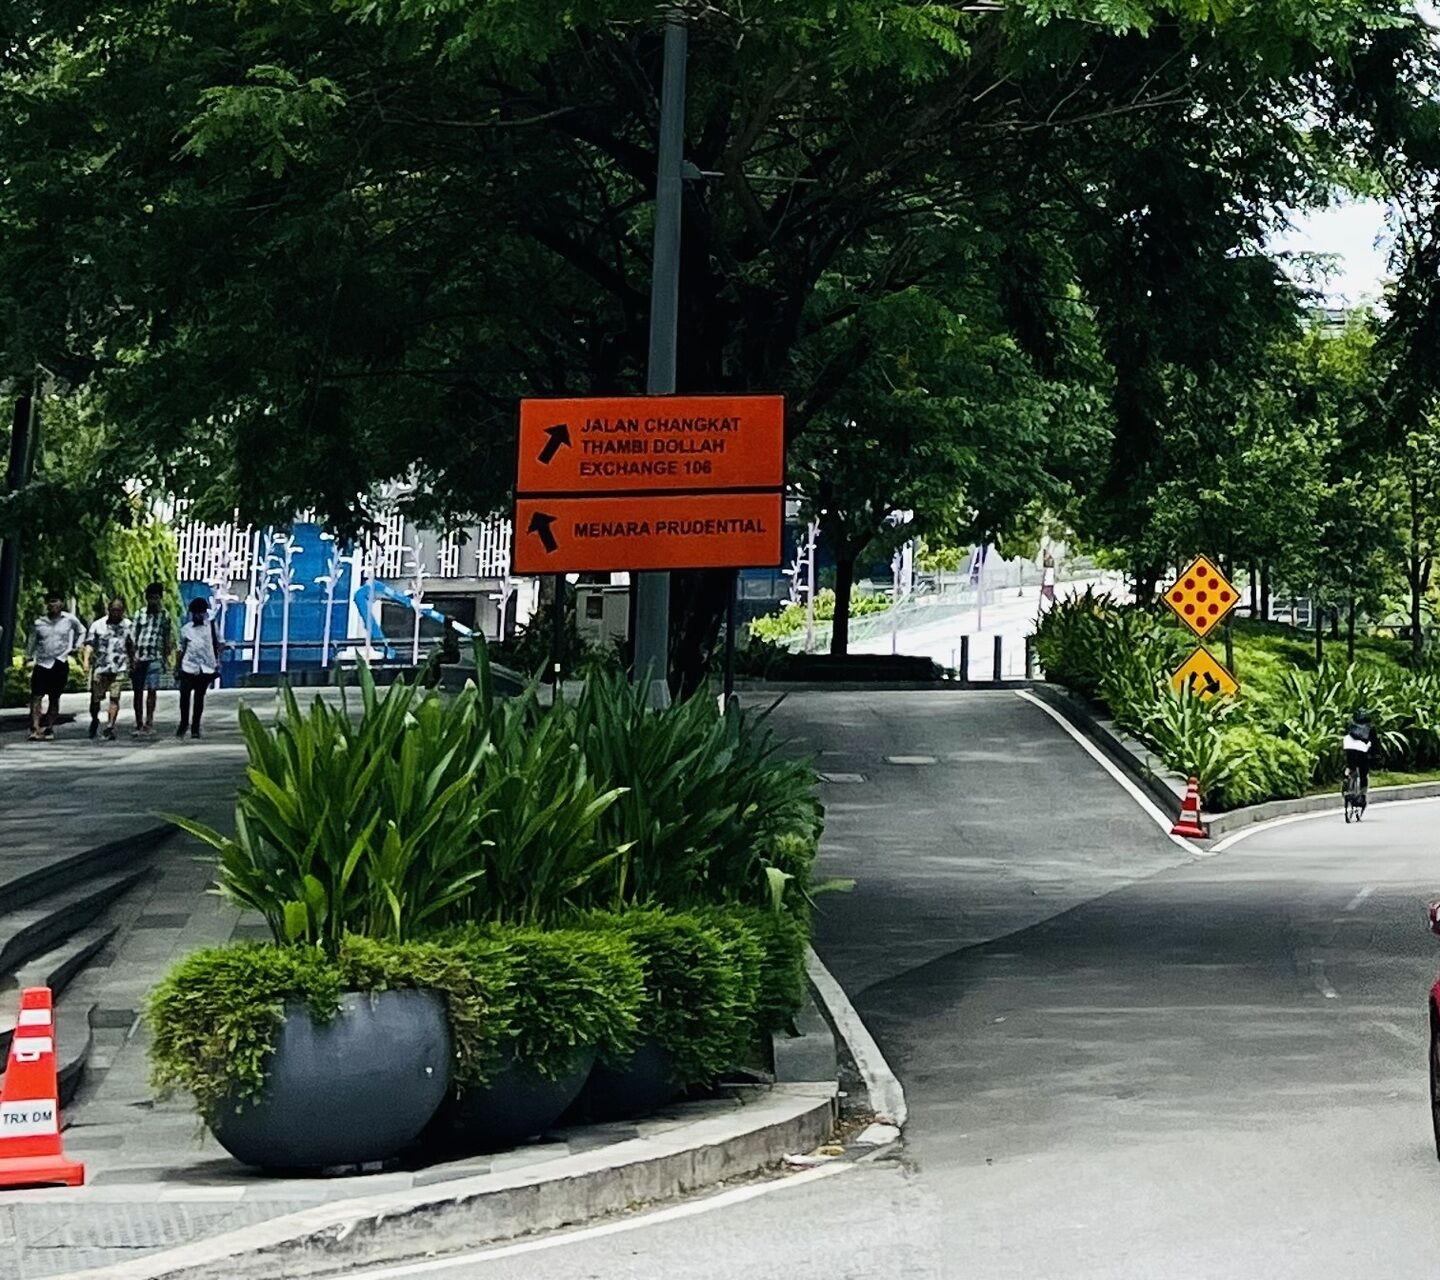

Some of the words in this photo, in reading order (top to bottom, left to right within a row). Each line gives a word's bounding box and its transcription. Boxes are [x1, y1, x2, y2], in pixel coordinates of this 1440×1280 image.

[581, 418, 639, 433] JALAN
[644, 417, 741, 432] CHANGKAT
[581, 439, 648, 454] THAMBI
[653, 438, 725, 453] DOLLAH
[579, 461, 678, 477] EXCHANGE
[684, 460, 713, 475] 106
[574, 521, 650, 538] MENARA
[655, 519, 767, 535] PRUDENTIAL
[3, 1113, 28, 1125] TRX
